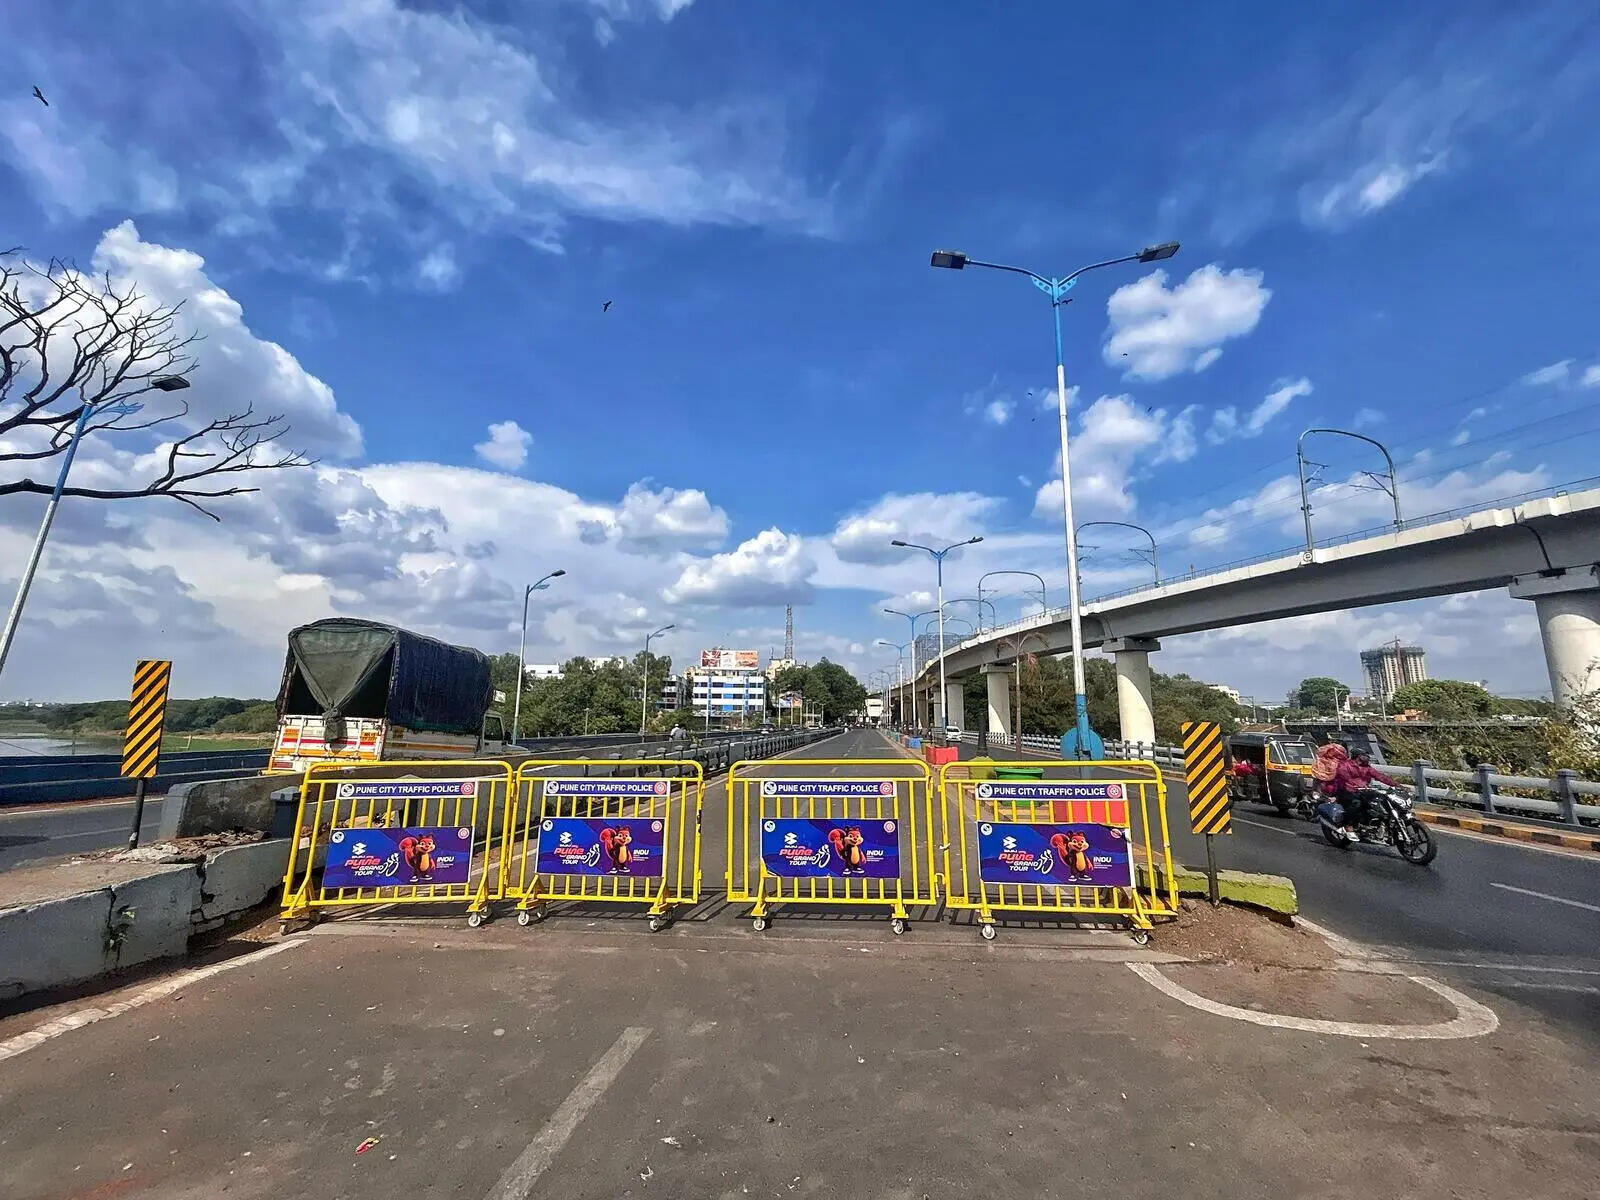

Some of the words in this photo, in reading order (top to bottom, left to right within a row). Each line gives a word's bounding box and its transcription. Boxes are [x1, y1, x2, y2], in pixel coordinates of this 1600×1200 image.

[355, 786, 378, 794] PUNE
[397, 785, 430, 793] TRAFFIC
[431, 785, 459, 793] POLICE
[560, 784, 579, 792] PUNE
[580, 784, 596, 792] CITY
[596, 784, 626, 792] TRAFFIC
[627, 784, 653, 792] POLICE
[994, 787, 1016, 795] PUNE
[1017, 787, 1037, 795] CITY
[1037, 787, 1073, 796] TRAFFIC
[1074, 788, 1106, 796] POLICE
